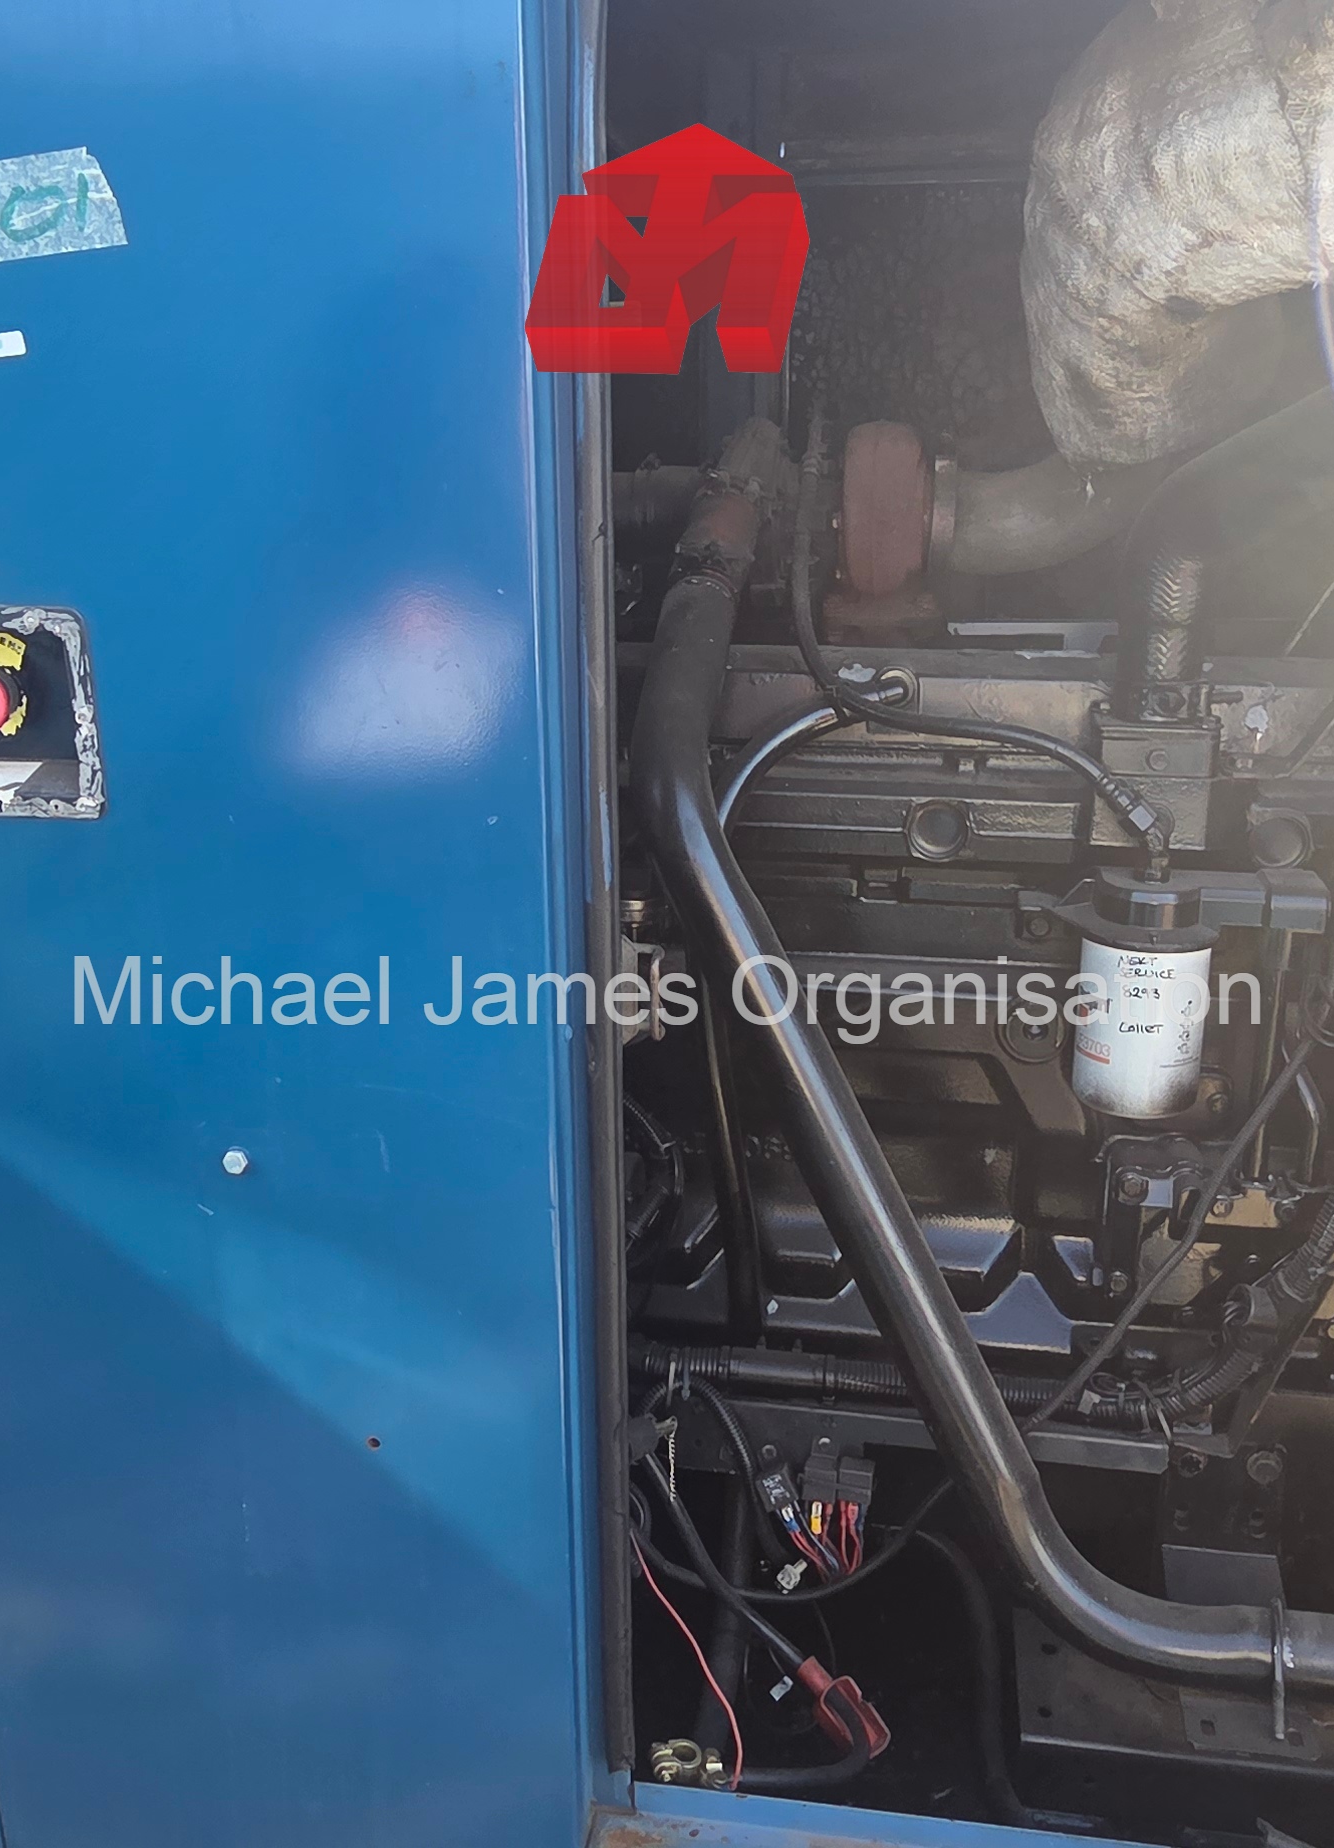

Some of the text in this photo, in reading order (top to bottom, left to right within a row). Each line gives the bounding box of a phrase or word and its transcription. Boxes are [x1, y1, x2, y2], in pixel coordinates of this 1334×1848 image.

[1117, 955, 1158, 968] NEXT
[1119, 968, 1177, 980] SERVICE
[1122, 984, 1161, 1000] 8293
